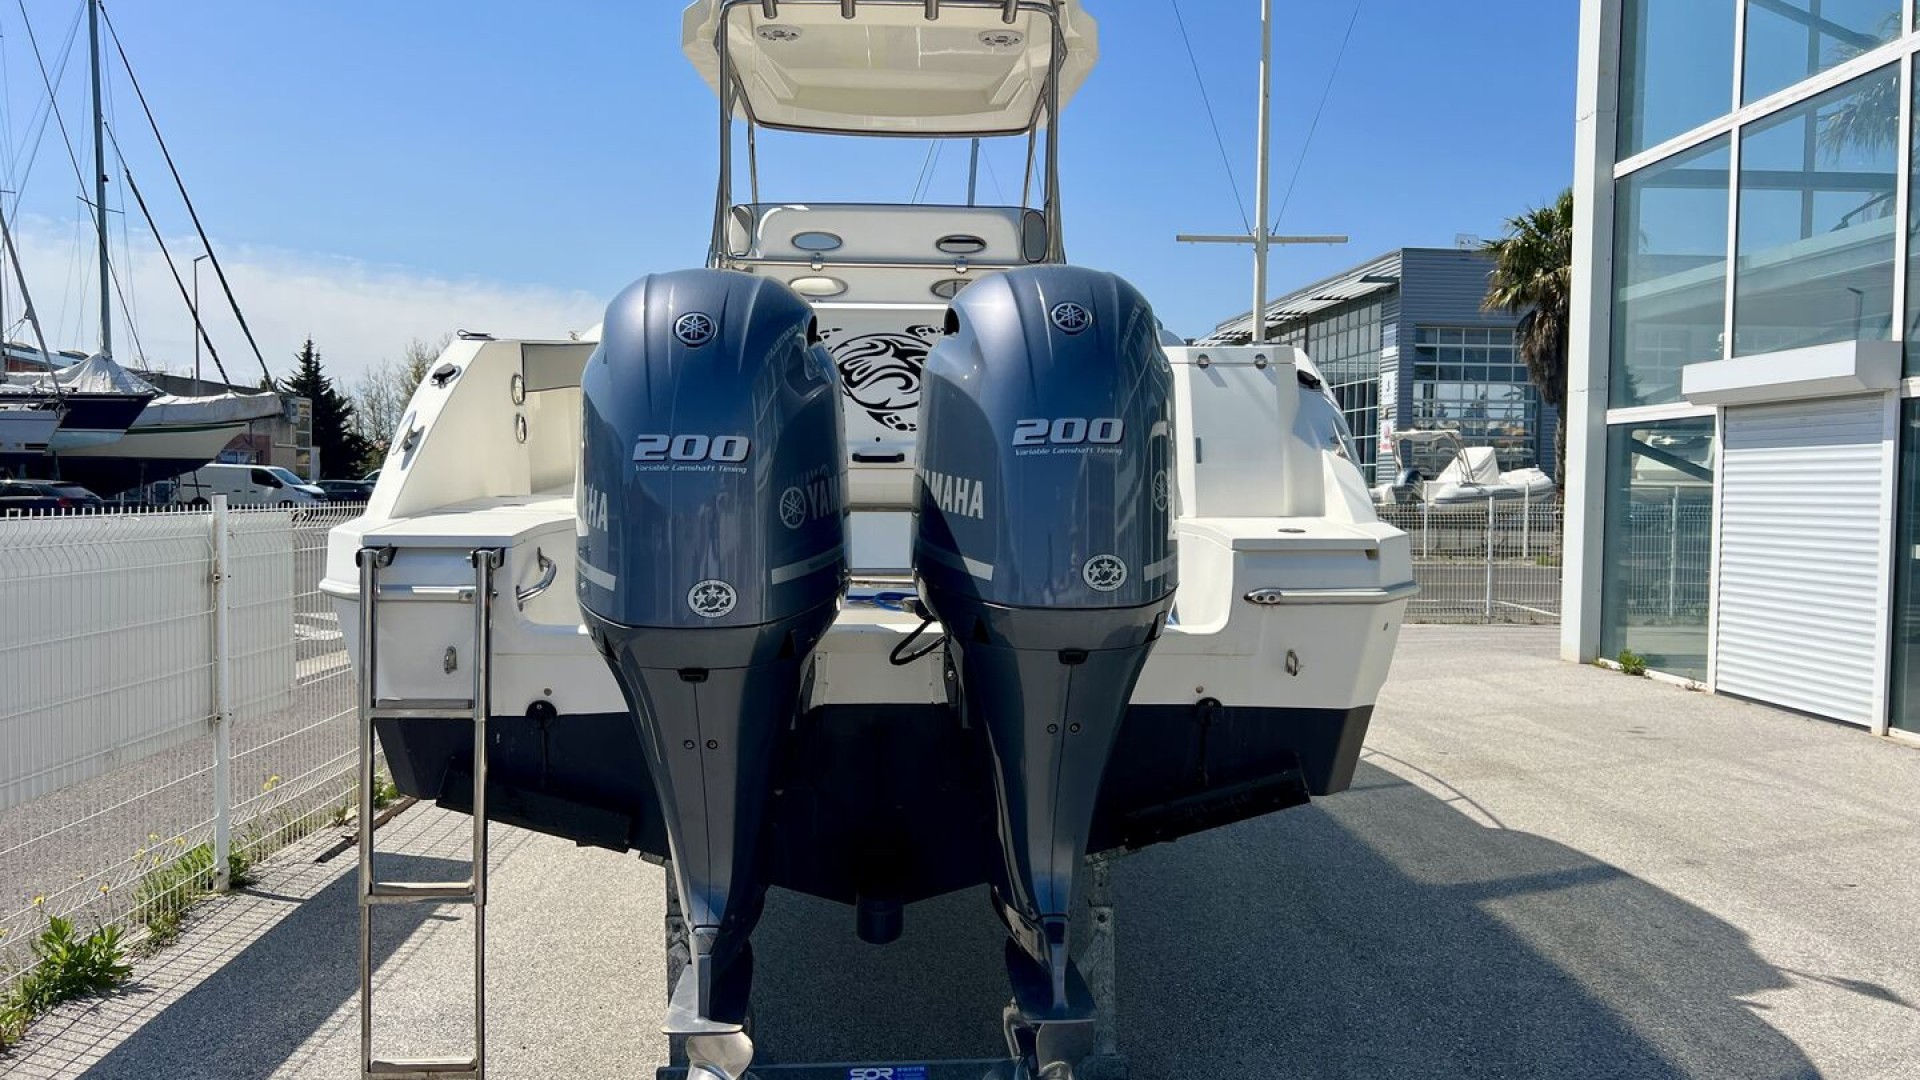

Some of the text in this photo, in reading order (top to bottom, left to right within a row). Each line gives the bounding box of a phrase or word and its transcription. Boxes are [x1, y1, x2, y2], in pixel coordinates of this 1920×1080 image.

[1012, 418, 1124, 445] 200
[632, 434, 750, 462] 200
[1015, 446, 1124, 456] Variable Camshaft Timing
[635, 463, 748, 475] Variable Camshaft Timing
